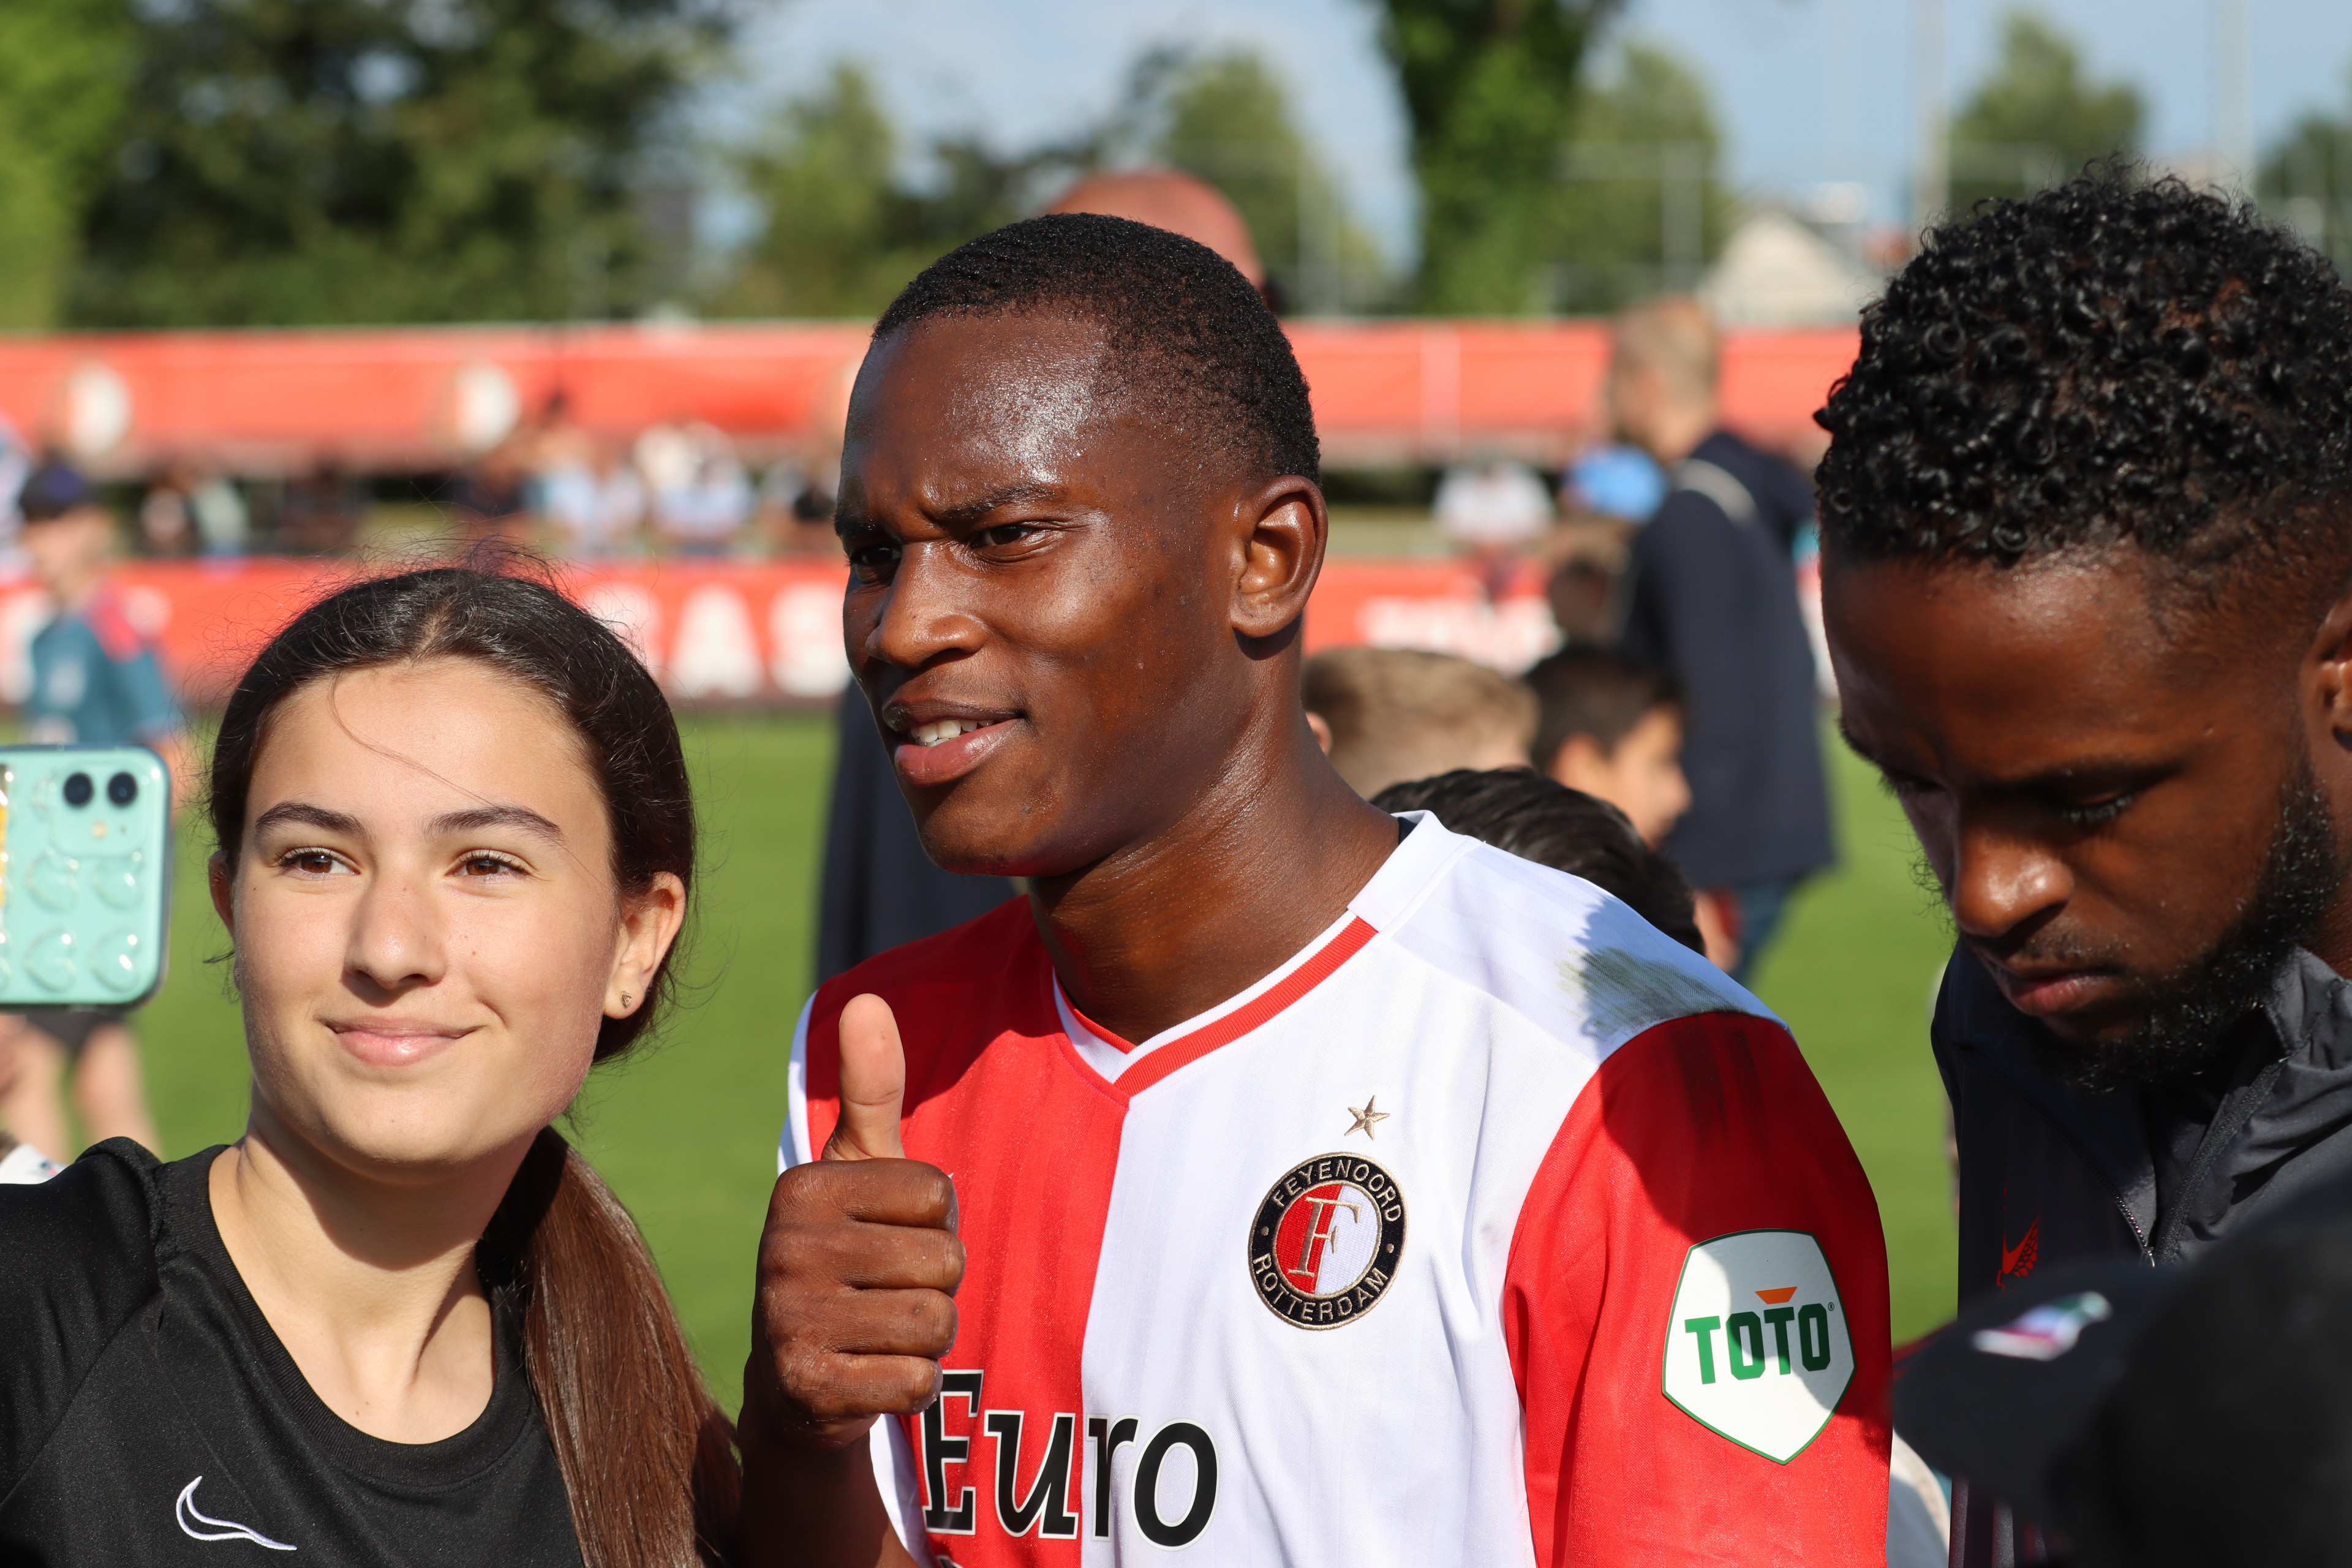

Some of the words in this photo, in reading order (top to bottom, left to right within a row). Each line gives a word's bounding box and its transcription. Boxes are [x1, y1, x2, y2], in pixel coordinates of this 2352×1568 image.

[1272, 1159, 1401, 1222] FEYENOORD
[1253, 1253, 1388, 1321] ROTTERDAM
[921, 1368, 1219, 1551] Euro
